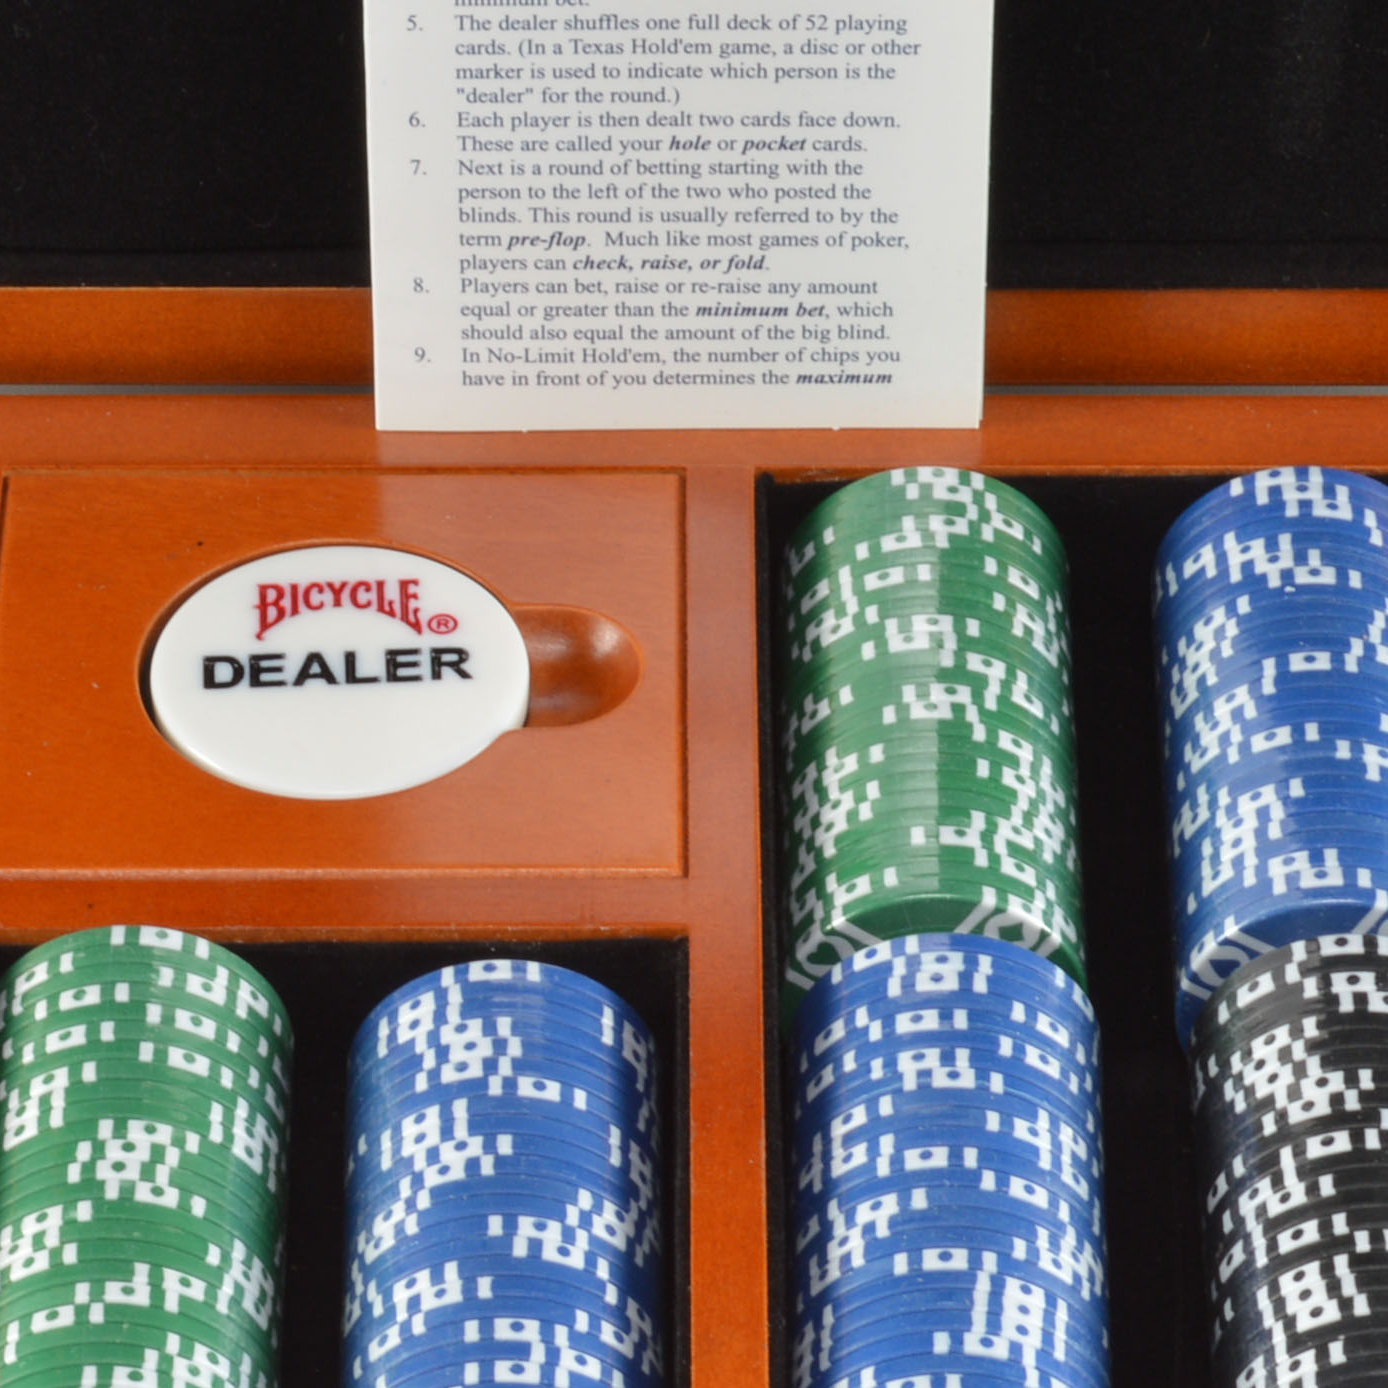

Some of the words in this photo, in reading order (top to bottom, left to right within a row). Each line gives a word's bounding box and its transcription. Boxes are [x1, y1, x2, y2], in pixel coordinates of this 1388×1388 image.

[407, 15, 422, 31] 5.
[454, 14, 492, 31] The
[498, 14, 557, 31] dealer
[564, 14, 639, 30] shuffles
[646, 19, 680, 30] one
[688, 14, 719, 30] full
[727, 14, 772, 30] deck
[778, 14, 801, 30] of
[806, 14, 828, 31] 52
[835, 14, 907, 35] playing
[455, 39, 510, 55] cards.
[518, 39, 545, 57] (In
[553, 44, 563, 55] a
[569, 39, 624, 55] Texas
[632, 38, 712, 54] Hold'em
[719, 43, 776, 59] game,
[783, 43, 793, 55] a
[800, 38, 838, 55] disc
[845, 44, 865, 55] or
[871, 39, 921, 55] other
[456, 63, 524, 79] marker
[531, 63, 545, 79] is
[553, 63, 596, 79] used
[602, 66, 620, 79] to
[628, 62, 703, 79] indicate
[710, 62, 767, 79] which
[775, 67, 838, 83] person
[846, 63, 860, 79] is
[867, 63, 896, 79] the
[457, 87, 533, 103] "dealer"
[542, 87, 569, 103] for
[575, 87, 603, 103] the
[610, 86, 680, 105] round.)
[409, 112, 425, 127] 6.
[458, 112, 504, 128] Each
[511, 111, 571, 132] player
[578, 112, 592, 127] is
[599, 111, 639, 127] then
[646, 111, 692, 127] dealt
[699, 114, 734, 127] two
[740, 111, 791, 127] cards
[799, 111, 836, 127] face
[843, 112, 900, 127] down.
[457, 136, 513, 152] These
[521, 140, 549, 152] are
[556, 136, 612, 152] called
[619, 140, 663, 155] your
[669, 135, 711, 151] hole
[717, 140, 737, 151] or
[741, 135, 807, 156] pocket
[812, 136, 867, 152] cards.
[411, 159, 426, 175] 7.
[459, 160, 503, 175] Next
[511, 160, 525, 175] is
[532, 164, 541, 175] a
[549, 160, 603, 175] round
[610, 159, 632, 175] of
[636, 159, 702, 179] betting
[709, 159, 780, 179] starting
[786, 159, 827, 175] with
[835, 160, 863, 175] the
[458, 188, 521, 204] person
[528, 186, 546, 199] to
[553, 184, 580, 199] the
[588, 183, 618, 199] left
[625, 183, 647, 199] of
[651, 183, 679, 199] the
[686, 186, 721, 199] two
[728, 183, 768, 199] who
[775, 184, 836, 204] posted
[843, 183, 871, 199] the
[459, 207, 521, 223] blinds.
[528, 207, 570, 223] This
[577, 207, 631, 223] round
[639, 207, 653, 223] is
[660, 206, 728, 227] usually
[735, 206, 809, 223] referred
[816, 210, 834, 223] to
[841, 208, 863, 228] by
[870, 208, 898, 224] the
[459, 234, 502, 246] term
[506, 231, 590, 251] pre-flop.
[605, 231, 659, 246] Much
[666, 230, 700, 246] like
[707, 234, 752, 246] most
[759, 235, 819, 251] games
[825, 231, 848, 247] of
[851, 231, 909, 251] poker,
[460, 254, 528, 274] players
[534, 259, 566, 270] can
[573, 254, 633, 272] check,
[641, 254, 692, 272] raise,
[700, 259, 721, 271] or
[727, 254, 769, 274] fold.
[414, 278, 428, 293] 8.
[461, 278, 529, 298] Players
[535, 283, 567, 294] can
[574, 278, 608, 295] bet,
[615, 278, 659, 293] raise
[665, 282, 685, 293] or
[691, 278, 761, 294] re-raise
[768, 283, 801, 298] any
[807, 282, 877, 294] amount
[460, 301, 510, 321] equal
[517, 306, 537, 317] or
[543, 304, 608, 321] greater
[615, 301, 654, 317] than
[661, 301, 689, 317] the
[696, 302, 788, 317] minimum
[796, 302, 829, 319] bet,
[837, 302, 893, 317] which
[462, 324, 523, 340] should
[530, 325, 567, 340] also
[573, 325, 623, 344] equal
[631, 325, 658, 340] the
[665, 328, 735, 340] amount
[741, 325, 763, 340] of
[767, 325, 795, 340] the
[802, 324, 830, 344] big
[838, 324, 889, 340] blind.
[415, 347, 430, 362] 9.
[462, 348, 480, 363] In
[488, 348, 574, 363] No-Limit
[582, 348, 666, 365] Hold'em,
[673, 347, 701, 363] the
[708, 347, 779, 362] number
[785, 347, 807, 362] of
[810, 347, 859, 366] chips
[866, 351, 900, 366] you
[462, 370, 505, 386] have
[512, 371, 529, 386] in
[536, 370, 580, 386] front
[587, 370, 608, 385] of
[612, 375, 646, 390] you
[653, 370, 755, 385] determines
[762, 370, 790, 384] the
[796, 369, 892, 384] maximum
[255, 578, 424, 640] BICYCLE
[203, 647, 472, 690] DEALER
